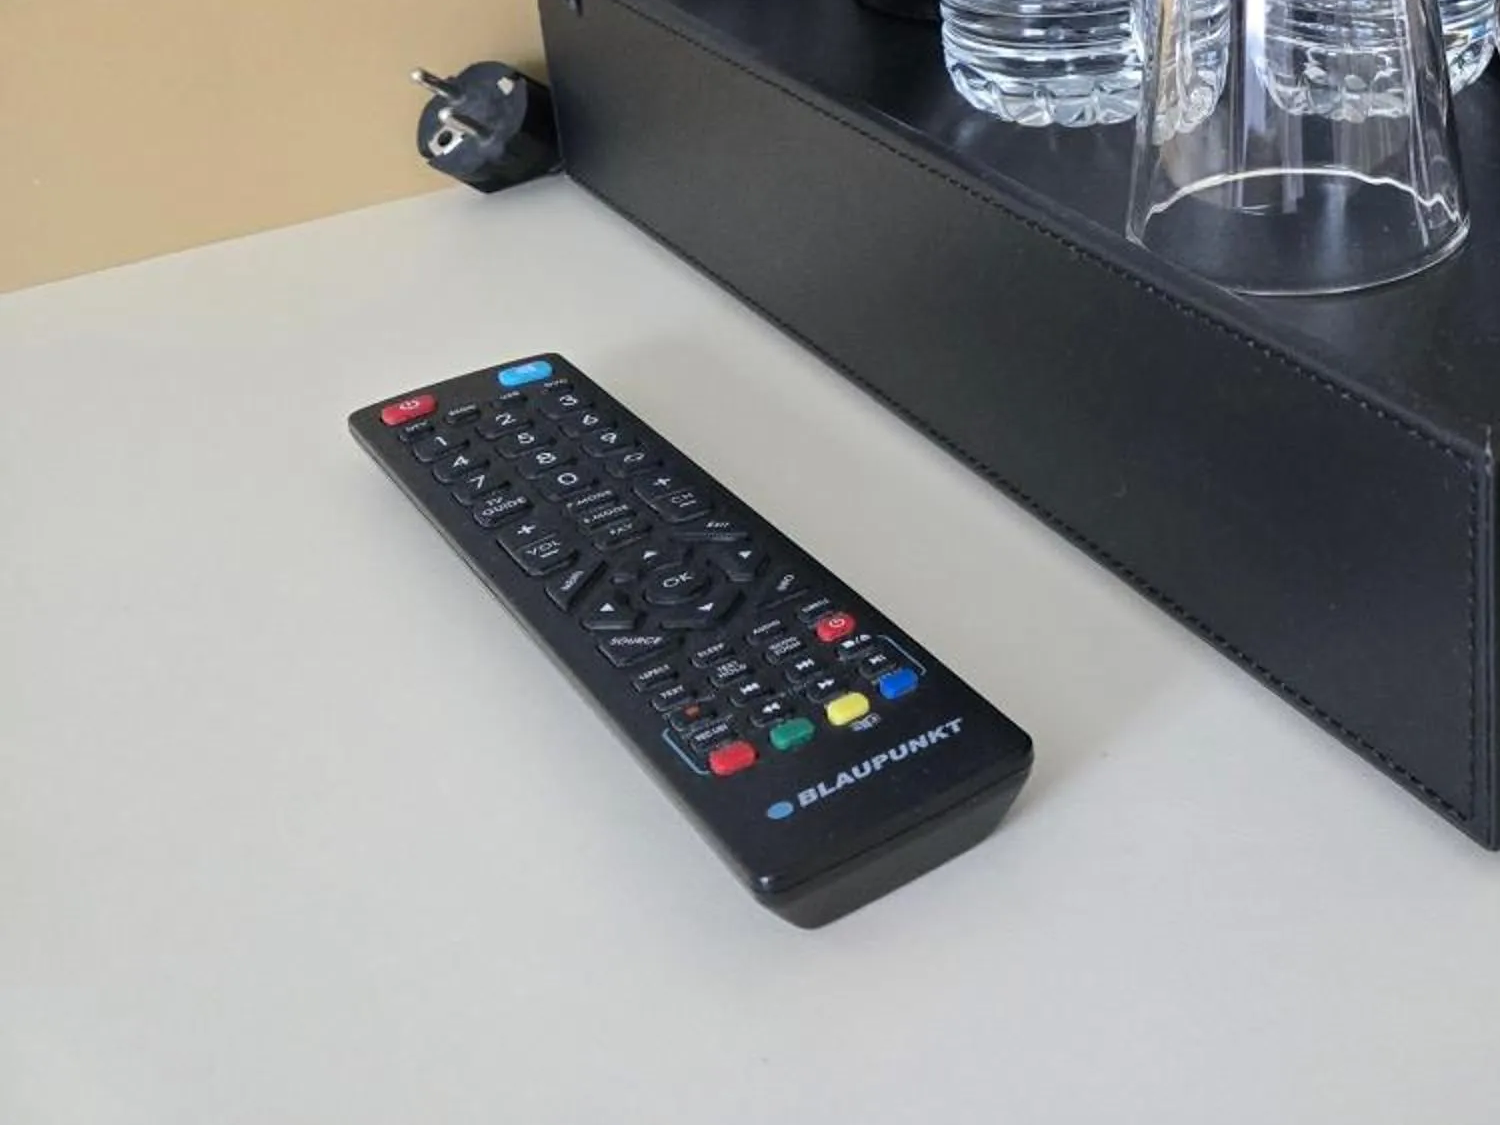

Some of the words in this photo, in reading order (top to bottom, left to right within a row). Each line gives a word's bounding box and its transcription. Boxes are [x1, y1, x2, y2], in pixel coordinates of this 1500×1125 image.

[559, 394, 579, 407] 3
[495, 412, 517, 426] 2
[582, 414, 599, 426] 6
[434, 435, 448, 447] 1
[517, 432, 535, 445] 5
[452, 455, 469, 468] 4
[535, 452, 557, 465] 8
[470, 475, 486, 489] 7
[482, 496, 528, 516] GUIDE
[525, 540, 562, 556] VOL
[662, 571, 696, 588] OK
[609, 636, 664, 647] SOURCE
[797, 717, 964, 810] BLAUPUNKT
